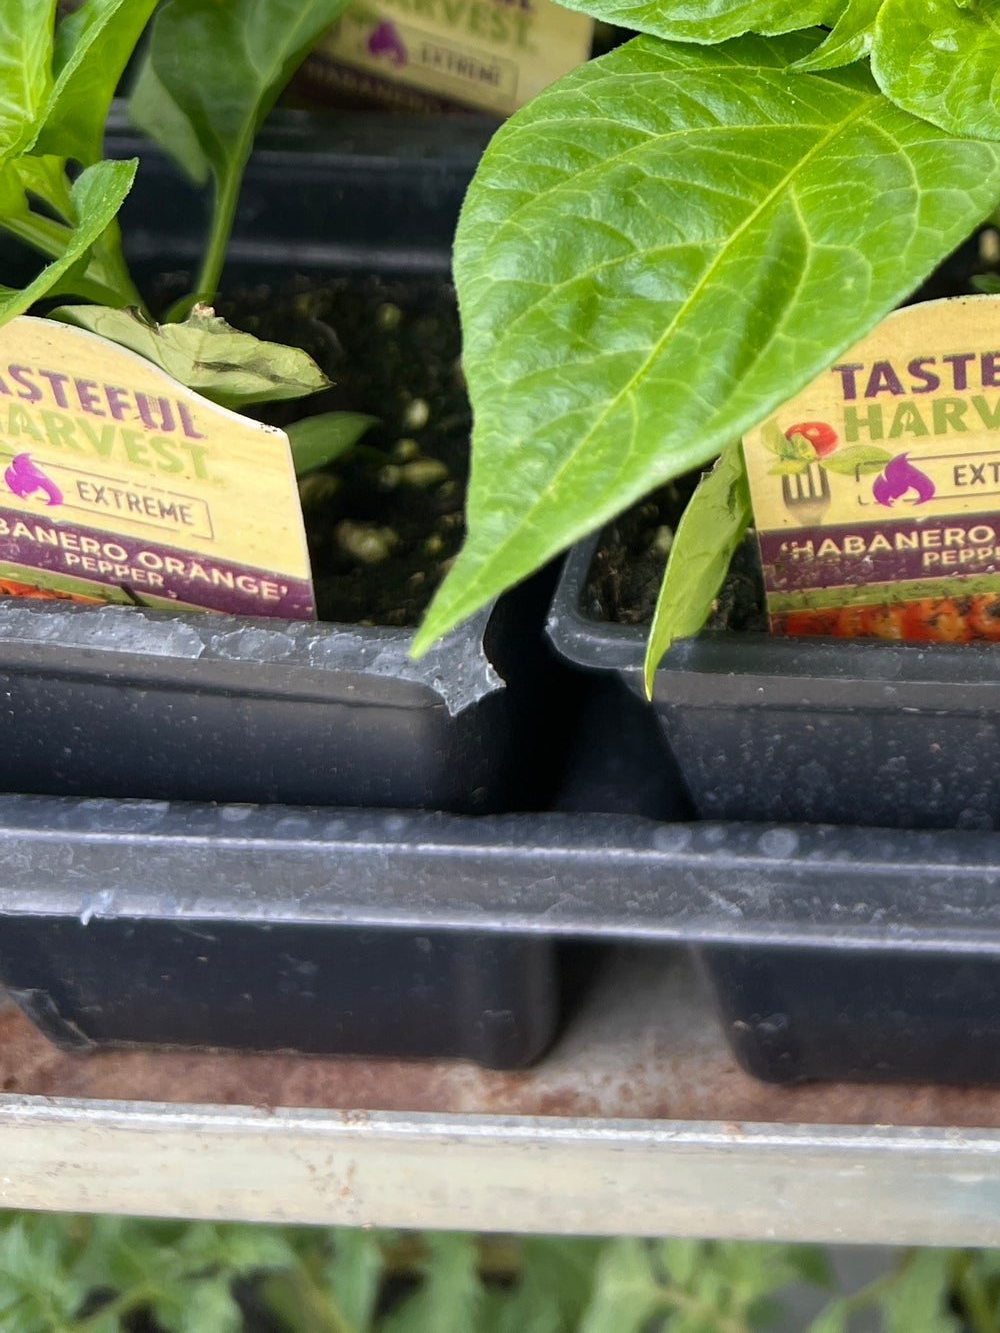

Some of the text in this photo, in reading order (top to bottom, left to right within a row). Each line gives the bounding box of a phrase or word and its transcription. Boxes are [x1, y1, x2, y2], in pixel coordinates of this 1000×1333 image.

[0, 403, 210, 480] ARVEST
[76, 480, 195, 526] EXTREME
[64, 552, 165, 588] PEPPER
